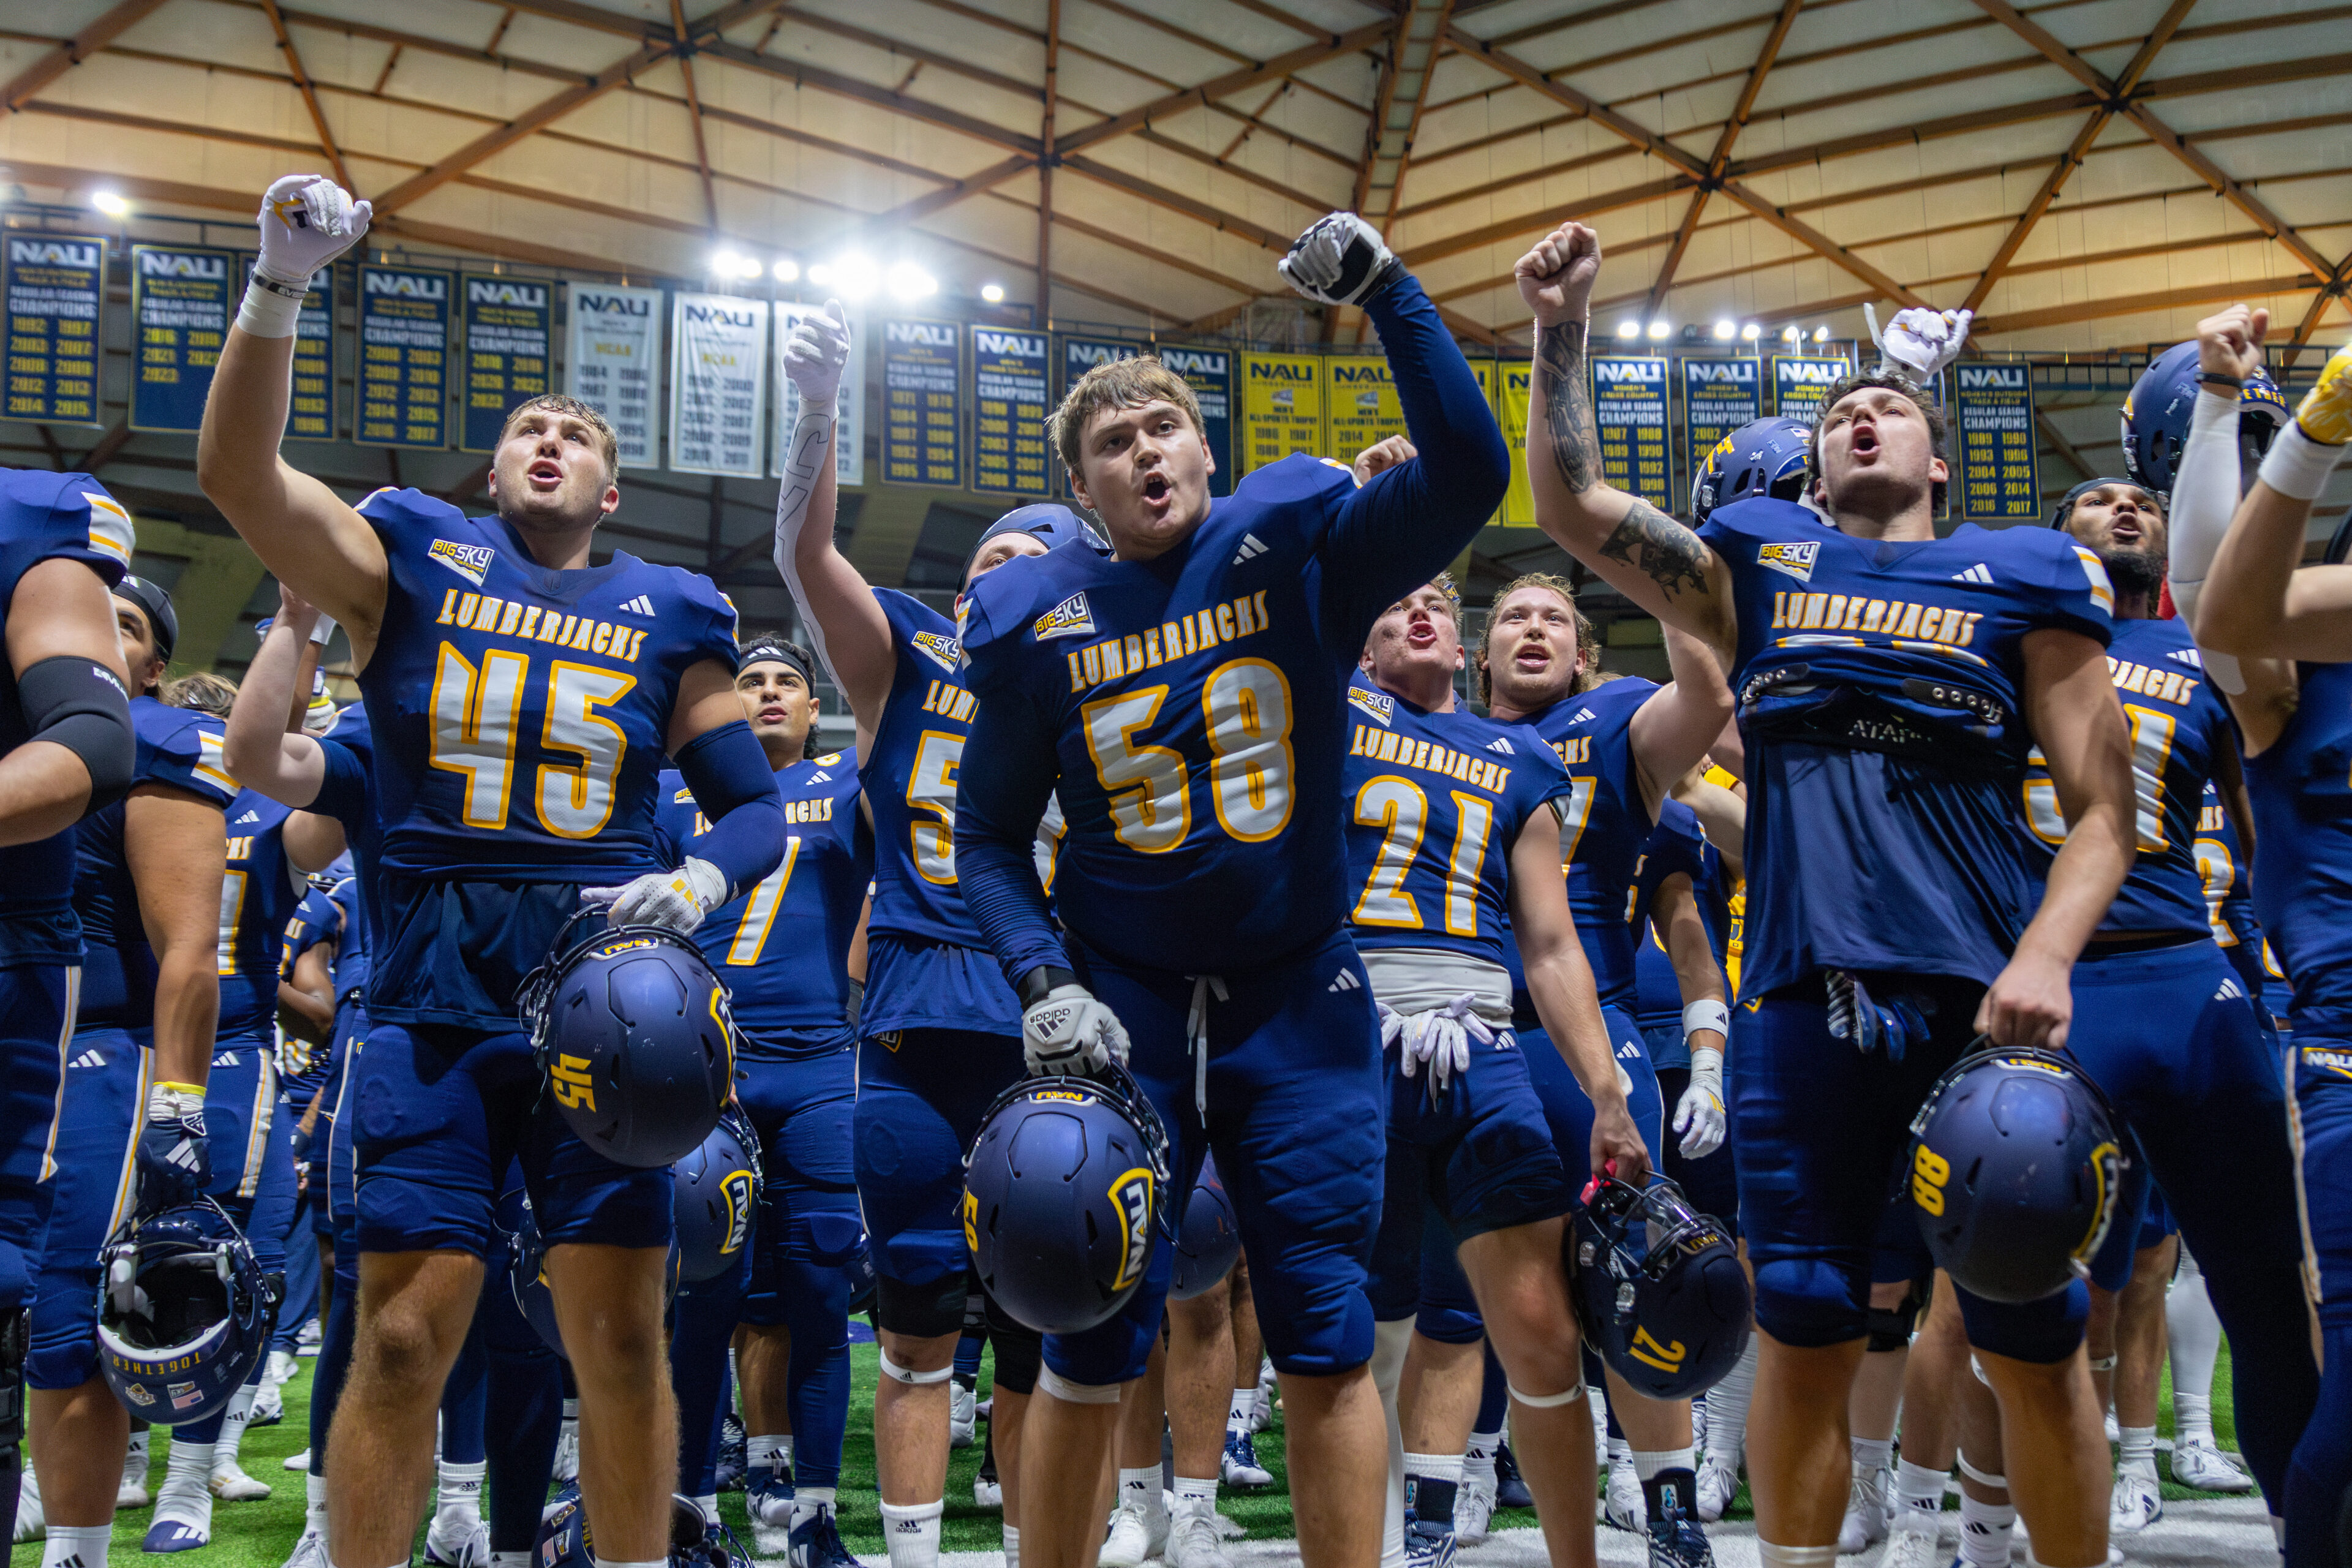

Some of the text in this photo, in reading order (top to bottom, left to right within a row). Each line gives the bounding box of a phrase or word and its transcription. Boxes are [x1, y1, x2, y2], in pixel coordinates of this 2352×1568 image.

[11, 241, 99, 268] NAU
[141, 252, 225, 279] NAU
[366, 271, 445, 299] NAU
[469, 281, 546, 308] NAU
[578, 294, 649, 317] NAU
[687, 305, 753, 327] NAU
[887, 323, 954, 347] NAU
[978, 333, 1044, 357] NAU
[1162, 350, 1226, 375] NAU
[1251, 363, 1313, 381] NAU
[1596, 363, 1661, 382] NAU
[1689, 363, 1753, 382] NAU
[1779, 363, 1843, 383] NAU
[1961, 369, 2023, 387] NAU
[1599, 401, 1663, 412] REGULAR SEASON
[1691, 401, 1754, 411] REGULAR SEASON
[1964, 407, 2026, 417] REGULAR SEASON
[1599, 412, 1664, 426] CHAMPIONS
[1691, 412, 1755, 425] CHAMPIONS
[1964, 417, 2027, 429] CHAMPIONS
[1694, 428, 1720, 440] 2002
[1969, 466, 2030, 479] 2004 2005
[2004, 482, 2030, 496] 2014
[2007, 500, 2030, 514] 2017
[454, 558, 484, 573] CONFERENCE
[435, 589, 649, 662] LUMBERJACKS
[1771, 592, 1983, 647] LUMBERJACKS
[1068, 590, 1269, 693] LUMBERJACKS
[429, 641, 637, 839] 45
[1081, 657, 1295, 853] 58
[1350, 725, 1511, 794] LUMBERJACKS
[1351, 775, 1493, 937] 21
[1029, 1007, 1071, 1023] adidas
[551, 1052, 597, 1114] 45
[1036, 1091, 1084, 1102] NAU
[1913, 1144, 1951, 1217] 88
[1121, 1181, 1147, 1279] NAU
[1629, 1324, 1687, 1374] 21
[113, 1351, 202, 1375] TOGETHER
